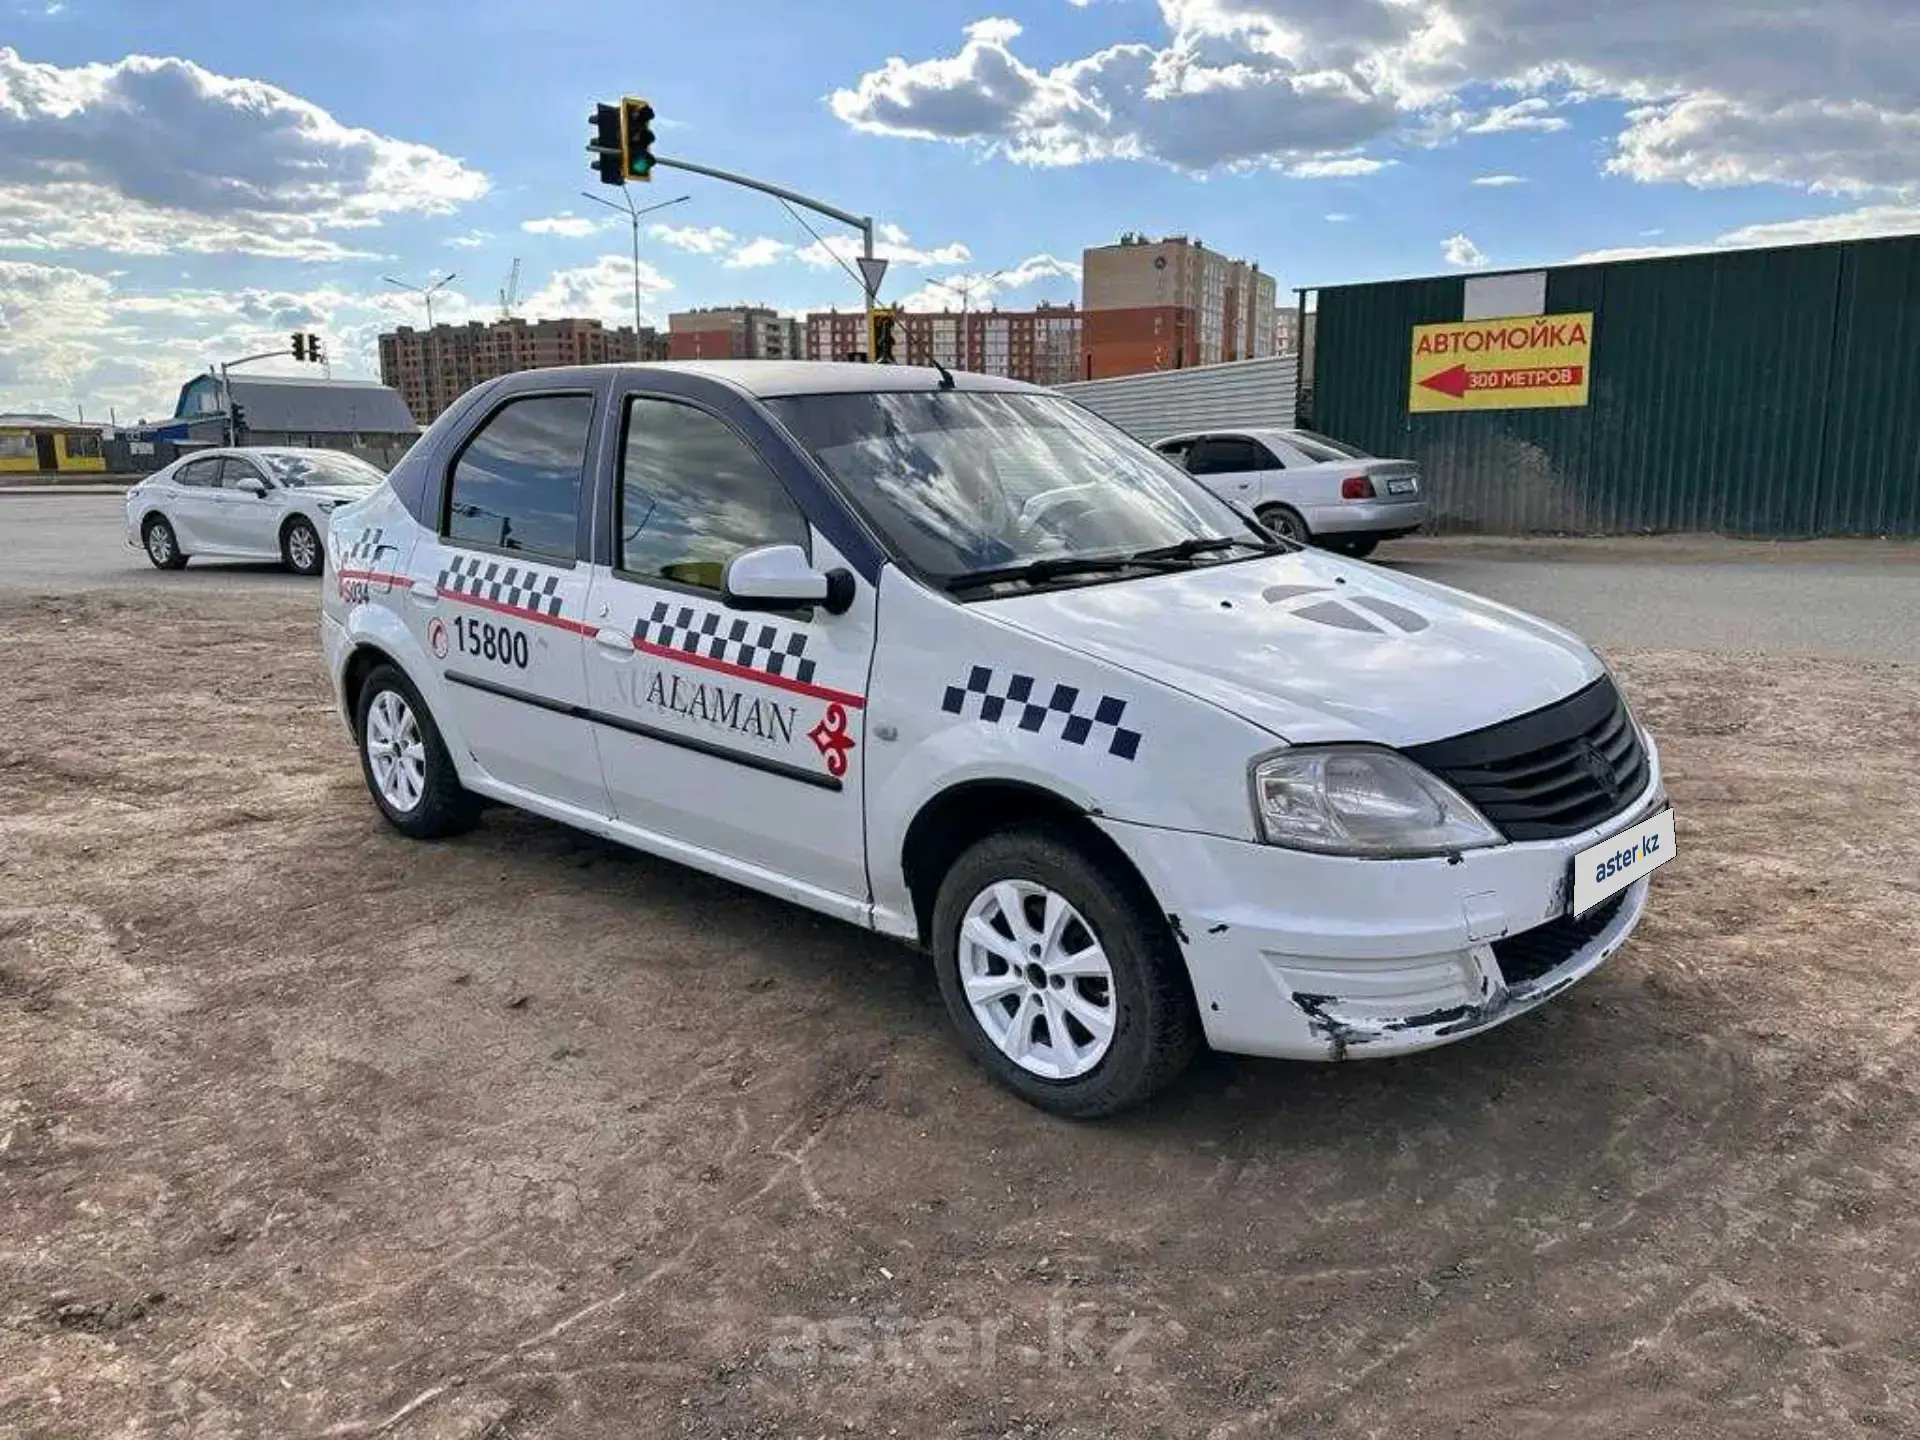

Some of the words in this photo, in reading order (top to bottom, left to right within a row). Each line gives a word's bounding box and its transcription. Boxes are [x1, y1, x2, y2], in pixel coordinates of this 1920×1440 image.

[1416, 319, 1587, 356] АВТОМОЙКА
[1469, 372, 1498, 388] 300
[1501, 369, 1573, 386] МЕТРОВ
[453, 616, 528, 669] 15800
[646, 672, 797, 744] ALAMAN
